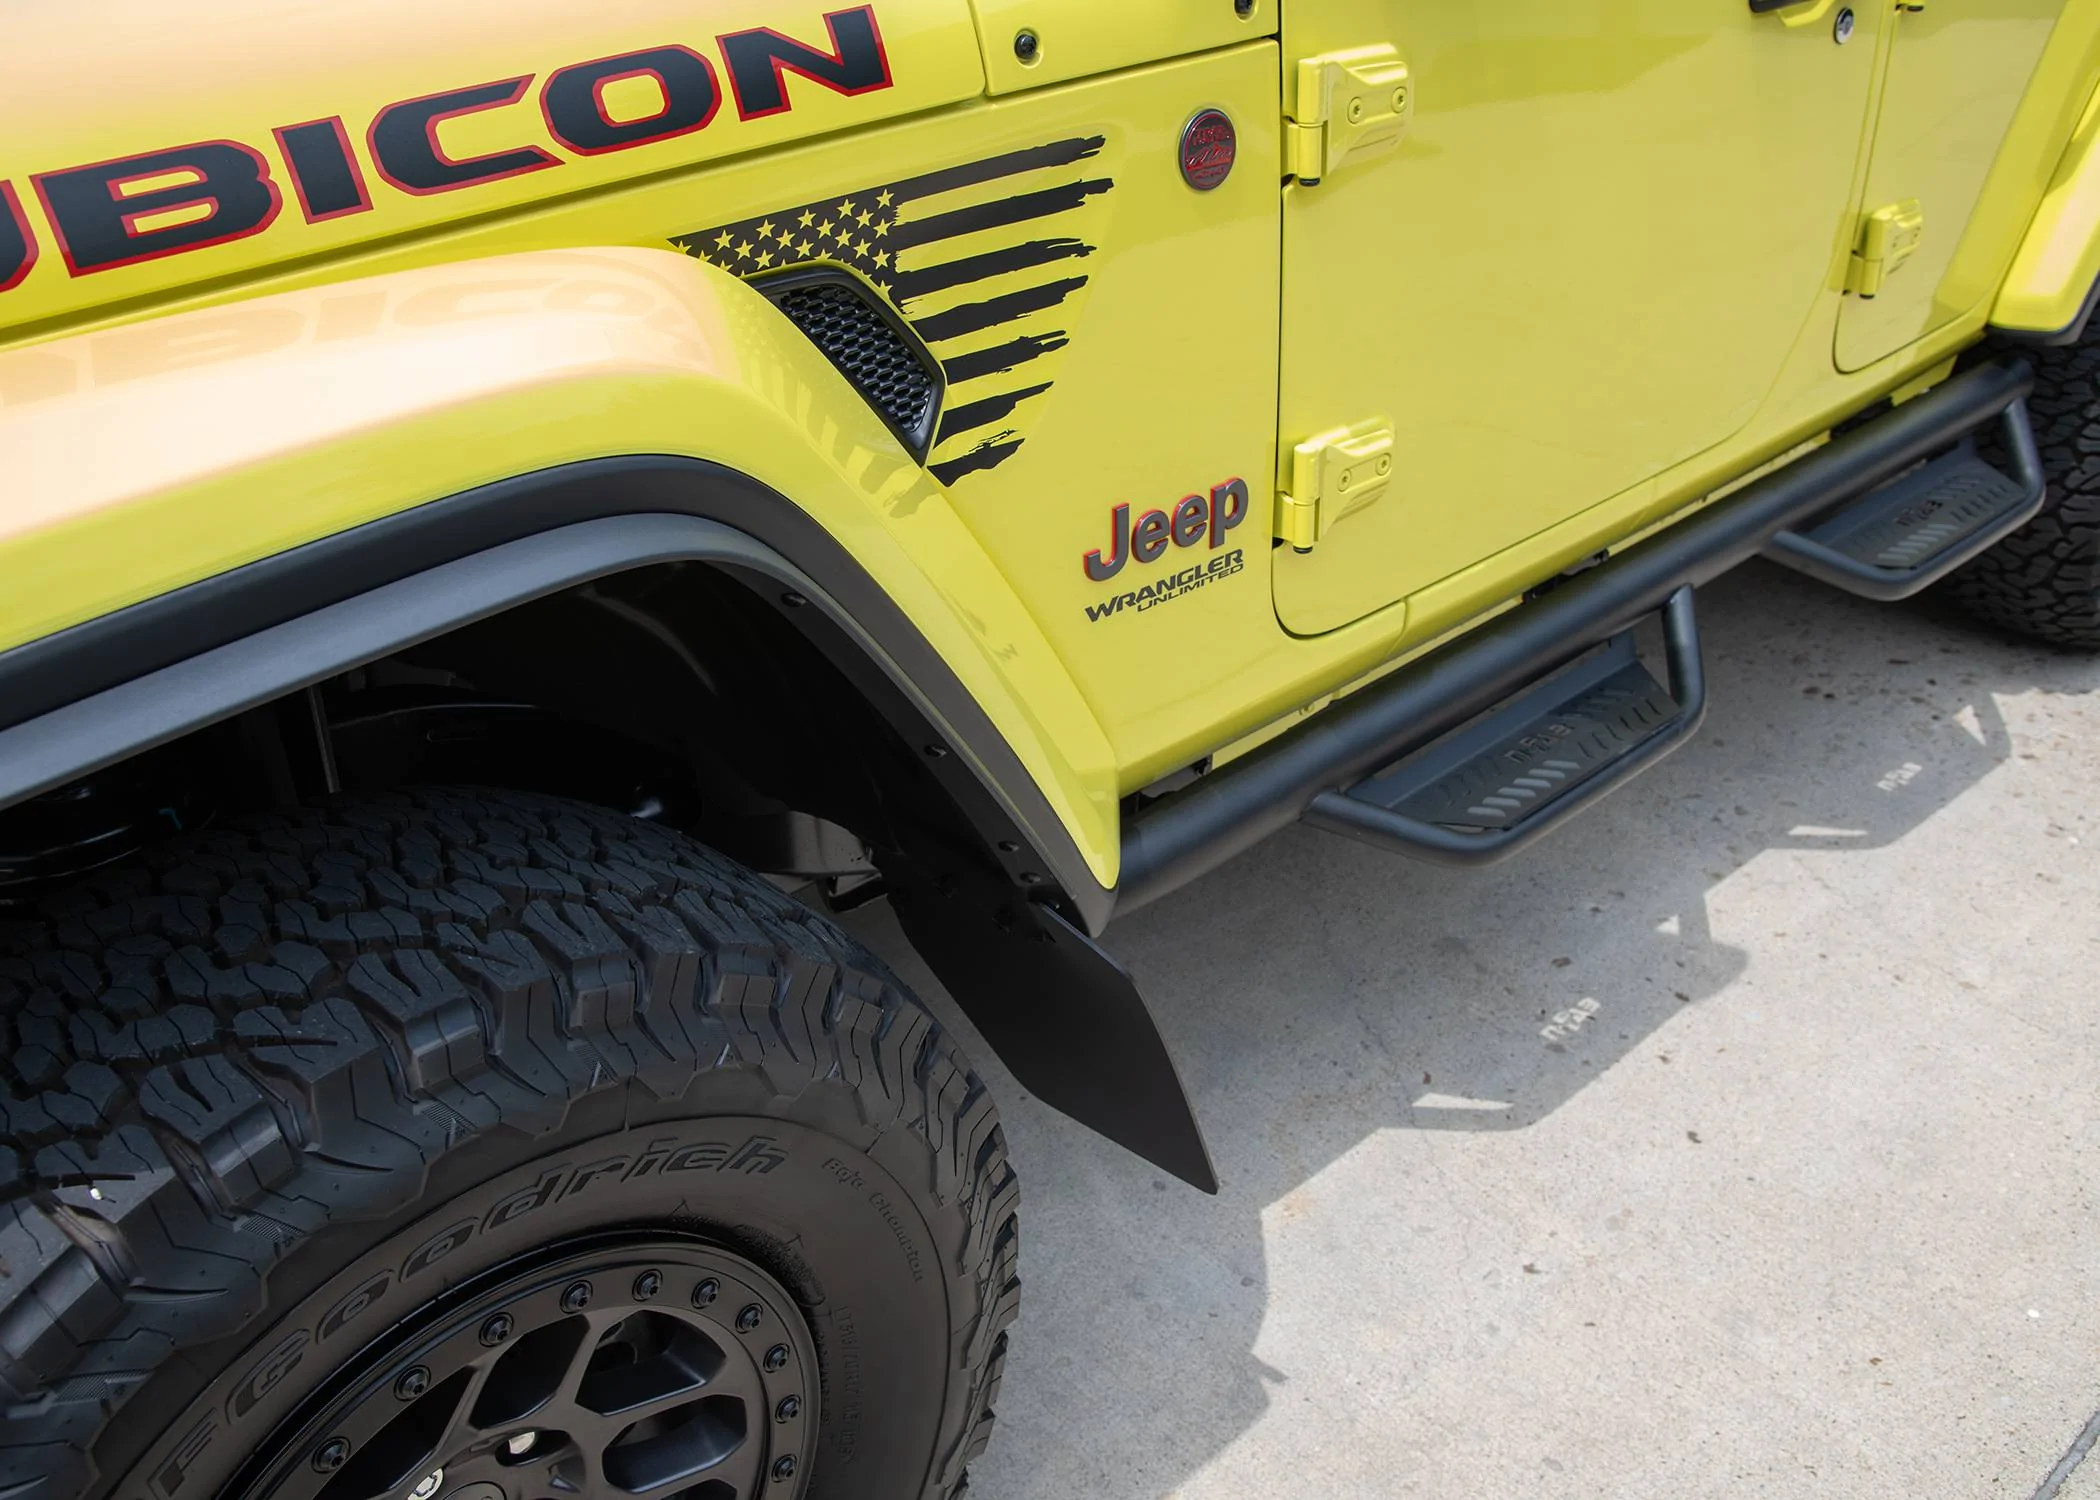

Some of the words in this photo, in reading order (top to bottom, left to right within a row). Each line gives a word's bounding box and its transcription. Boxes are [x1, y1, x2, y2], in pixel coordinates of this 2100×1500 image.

[0, 4, 895, 294] BICON
[1083, 476, 1249, 582] Jeep
[1085, 548, 1244, 623] WRANGLER
[1137, 563, 1244, 613] UNLIMITED
[137, 1132, 790, 1500] FGoodrich
